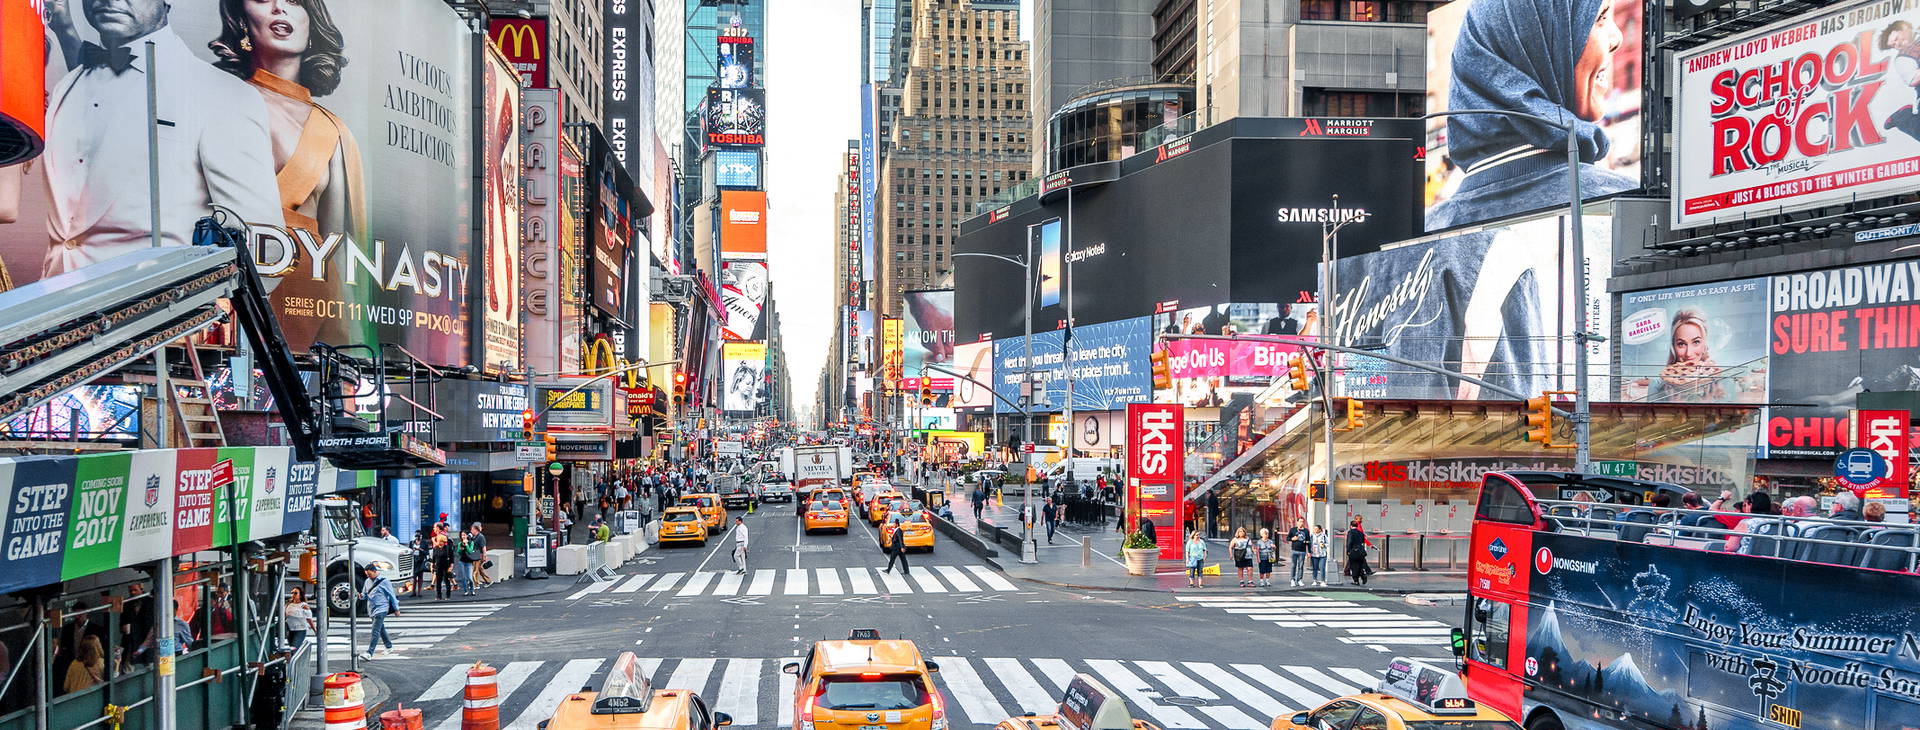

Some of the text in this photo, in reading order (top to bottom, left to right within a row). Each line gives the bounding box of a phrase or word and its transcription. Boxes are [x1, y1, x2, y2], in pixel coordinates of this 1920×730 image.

[723, 28, 749, 37] 2017
[1734, 37, 1768, 60] LLOYD
[1771, 23, 1817, 48] WEBBER
[1820, 16, 1845, 36] HAS
[612, 27, 626, 101] EXPRESS
[1711, 30, 1891, 117] SCHOOL
[1774, 84, 1812, 124] of
[1327, 119, 1375, 127] MARRIOTT
[1327, 127, 1369, 135] MARQUIS
[1711, 80, 1888, 177] ROCK
[708, 134, 764, 145] TOSHIBA
[864, 132, 872, 174] NINJAS
[1769, 162, 1781, 170] THE
[1778, 160, 1810, 175] MUSICAL
[1732, 159, 1919, 205] JUST 4 BLOCKS TO THE WINTER GARDEN
[526, 105, 547, 315] PALACE
[1278, 208, 1365, 223] SAMSUNG
[1085, 243, 1105, 259] Note8
[247, 222, 470, 306] DYNASTY
[284, 296, 314, 309] SERIES
[1331, 248, 1443, 347] Honestly
[1637, 294, 1656, 304] ONLY
[1658, 292, 1673, 300] LIFE
[1675, 290, 1696, 299] WERE
[1696, 288, 1707, 296] AS
[1709, 286, 1729, 295] EASY
[1730, 285, 1741, 293] AS
[1743, 283, 1756, 291] PIE
[284, 307, 314, 317] PREMIERE
[316, 299, 345, 320] OCT
[348, 303, 362, 321] 11
[366, 304, 396, 325] WED
[398, 308, 413, 327] 9P
[1636, 319, 1652, 328] SARA
[1773, 311, 1847, 355] SURE
[908, 329, 955, 345] KNOW TH
[1004, 343, 1127, 369] Next you leave the city,
[1190, 347, 1225, 369] On Us
[1081, 365, 1103, 380] places
[1104, 361, 1122, 377] from
[1123, 360, 1131, 375] it.
[1115, 396, 1127, 404] OUT
[1127, 395, 1135, 403] OF
[1118, 387, 1141, 395] UNITED
[478, 393, 512, 410] STAY IN THE
[483, 412, 498, 428] NEW
[318, 436, 388, 447] NORTH SHORE
[560, 443, 598, 451] NOVEMBER
[1142, 409, 1175, 475] tkts
[290, 463, 315, 483] STEP
[1366, 460, 1408, 482] tkts
[1601, 463, 1611, 474] W
[1614, 463, 1625, 474] 47
[82, 479, 106, 490] COMING
[179, 469, 212, 492] STEP
[288, 482, 314, 495] INTO THE
[1444, 480, 1481, 490] Develop
[1838, 477, 1881, 492] NO STANDING
[15, 483, 69, 514] STEP
[77, 487, 122, 520] NOV
[178, 493, 211, 508] INTO THE
[255, 497, 281, 512] EXPERIENCE
[287, 495, 313, 513] GAME
[1382, 504, 1389, 513] 2
[1416, 504, 1424, 513] 3
[1450, 504, 1457, 513] 4
[178, 507, 211, 529] GAME
[218, 498, 248, 524] 217
[11, 512, 64, 534] INTO THE
[129, 511, 168, 532] EXPERIENCE
[72, 515, 119, 549] 2017
[7, 530, 62, 561] GAME
[1553, 557, 1596, 574] NONGSHIM
[1684, 603, 1736, 645] Enjoy
[1738, 622, 1787, 649] Your
[1789, 627, 1896, 655] Summer
[1705, 652, 1748, 676] with
[1786, 660, 1870, 688] Noodle
[1770, 703, 1801, 728] SHIN
